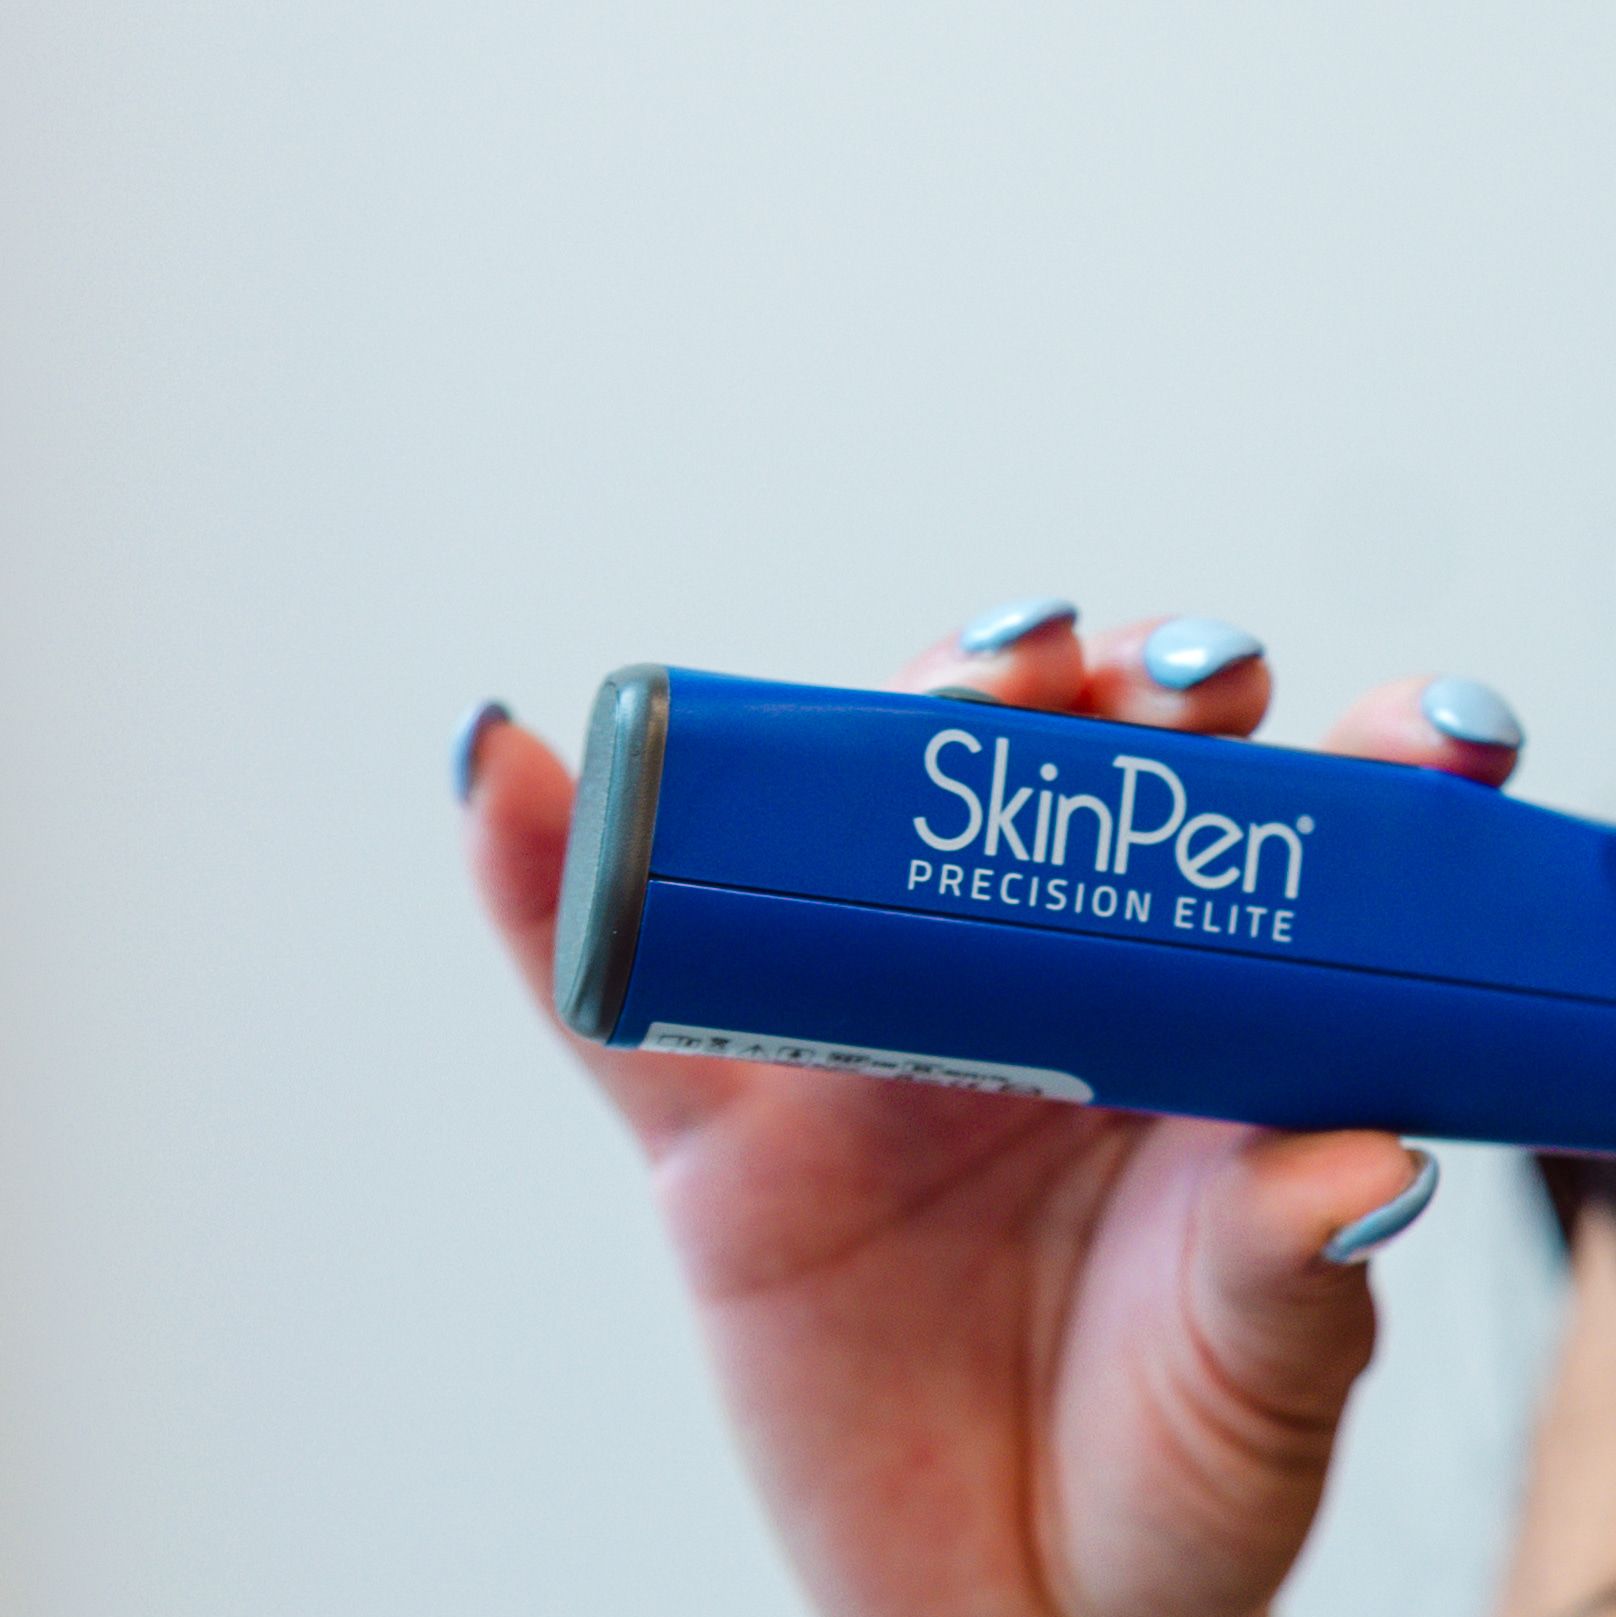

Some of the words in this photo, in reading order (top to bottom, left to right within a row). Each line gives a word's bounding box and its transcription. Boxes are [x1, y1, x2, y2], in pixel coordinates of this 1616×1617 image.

[912, 728, 1303, 900] SkinPen
[907, 859, 1152, 923] PRECISION
[1173, 896, 1296, 944] ELITE
